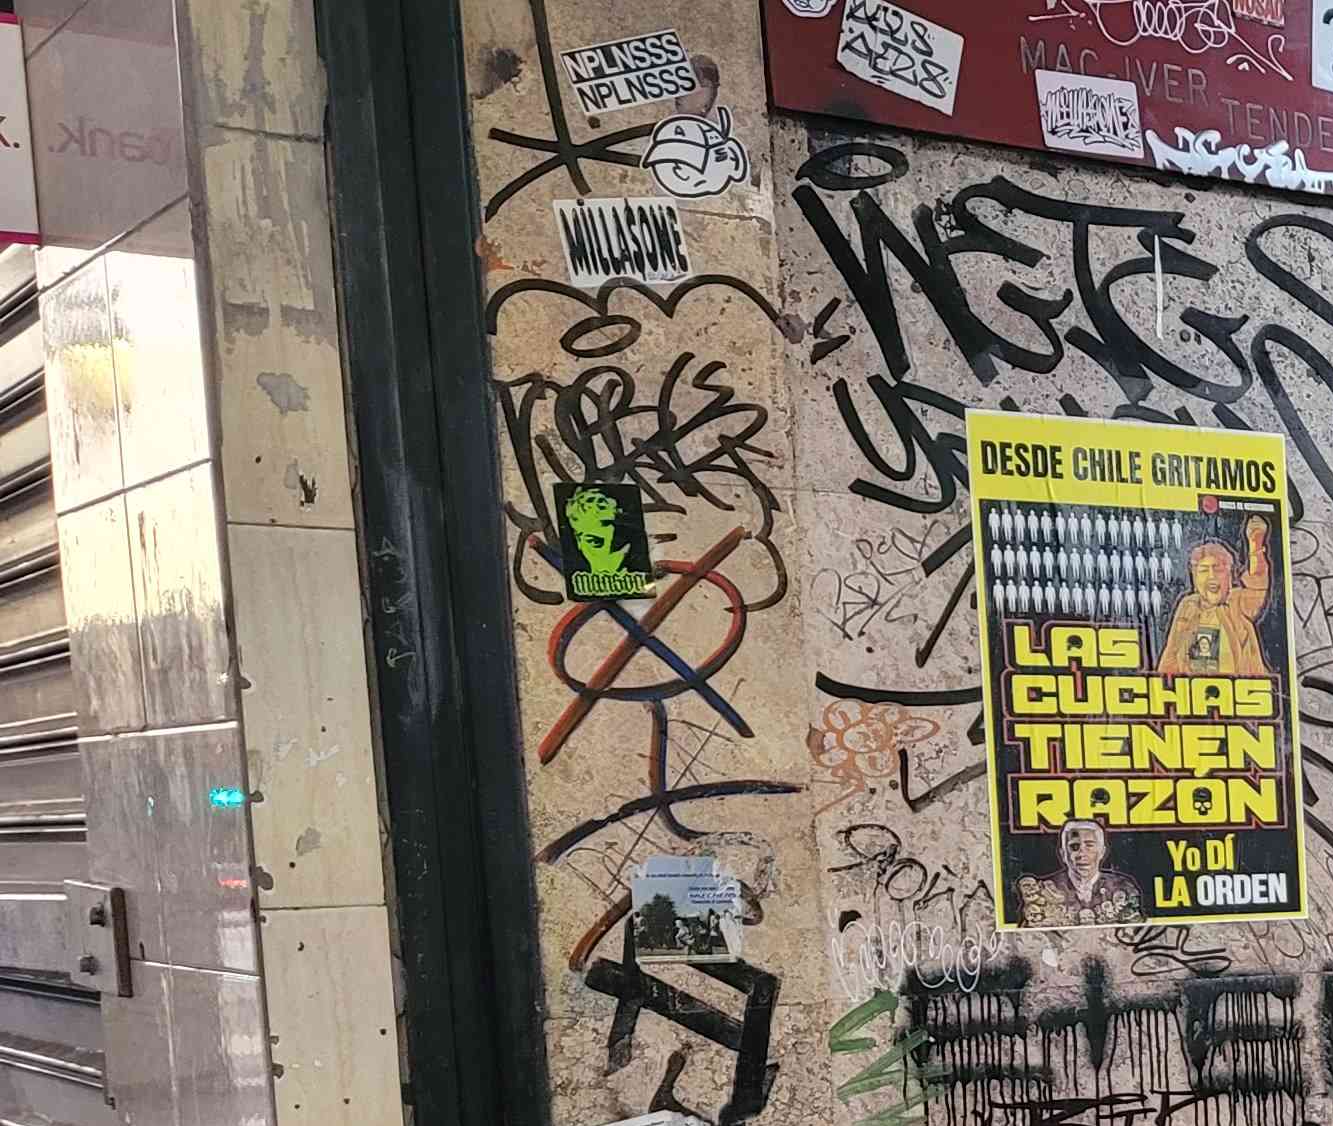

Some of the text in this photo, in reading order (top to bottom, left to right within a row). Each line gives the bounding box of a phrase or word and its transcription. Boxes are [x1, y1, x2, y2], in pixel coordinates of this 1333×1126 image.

[563, 34, 684, 82] NPLNSSS
[577, 65, 696, 113] NPLNSSS
[980, 440, 1277, 494] DESDE CHILE GRITAMOS
[1012, 624, 1140, 671] LAS
[1010, 673, 1275, 718] CUCHAS
[1014, 723, 1277, 773] TIENEN
[1154, 872, 1289, 909] LA ORDEN
